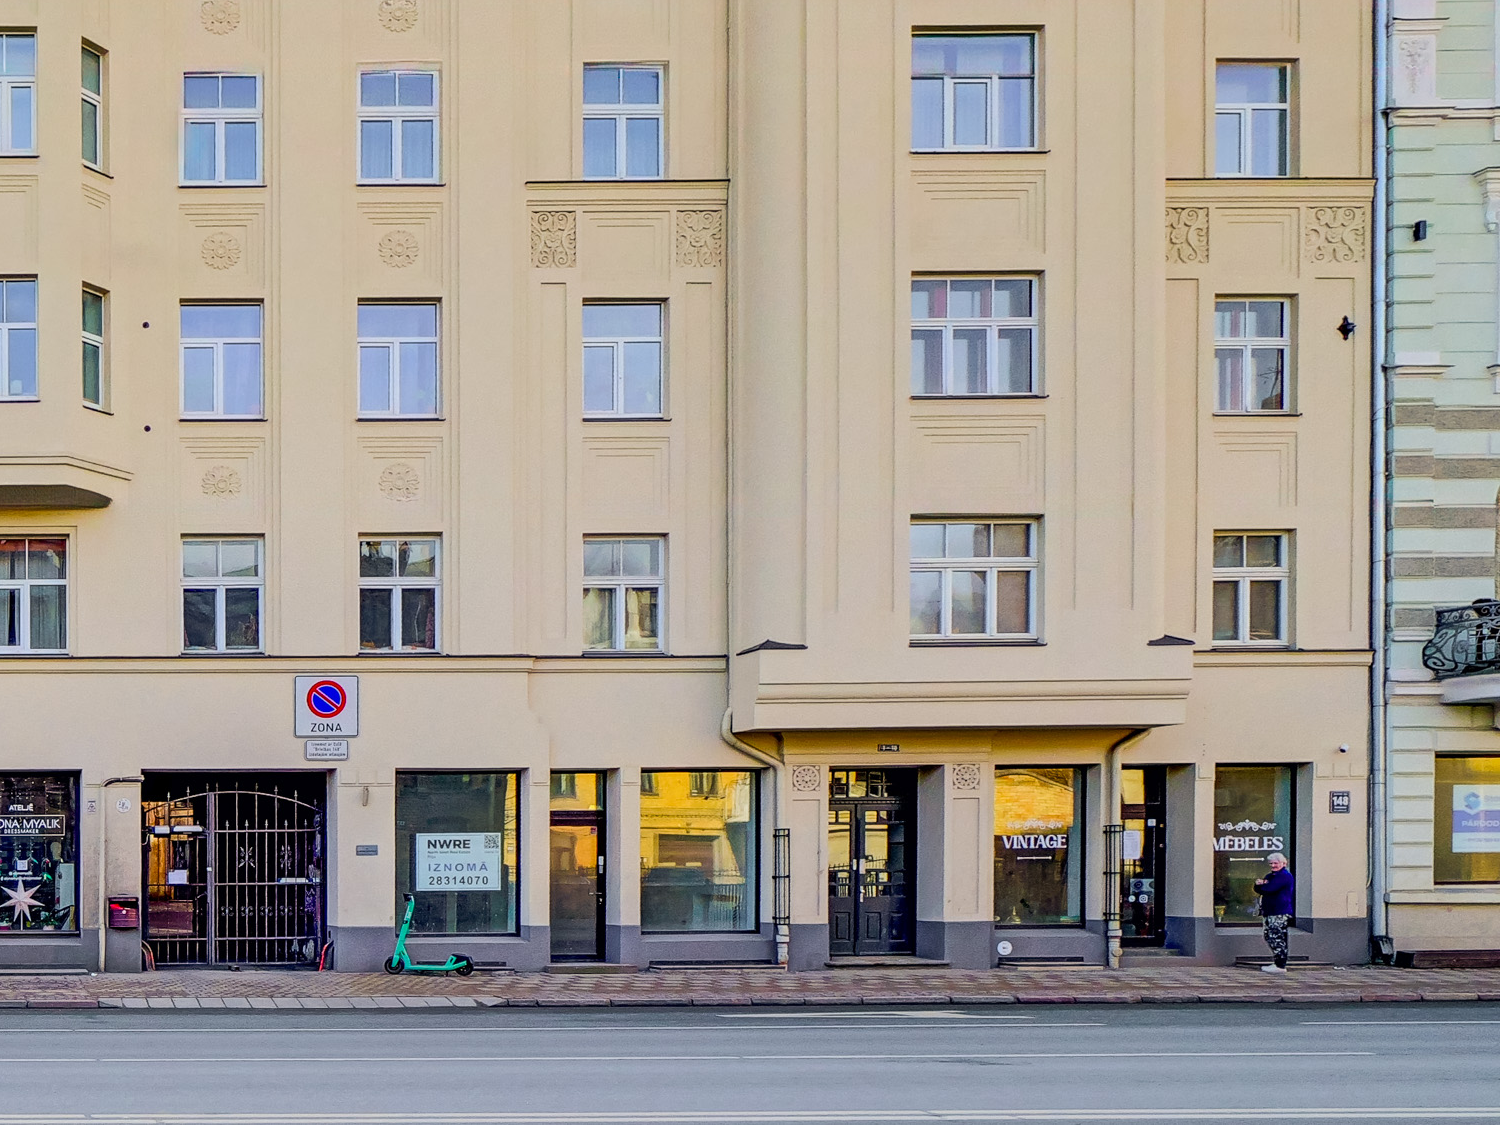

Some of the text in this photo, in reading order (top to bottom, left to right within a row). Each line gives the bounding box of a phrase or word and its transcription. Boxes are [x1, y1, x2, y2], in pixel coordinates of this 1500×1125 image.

[311, 723, 342, 732] ZONA
[1332, 796, 1349, 806] 148
[9, 803, 33, 811] ATELJĒ
[23, 819, 60, 828] MYALIK
[427, 839, 471, 850] NWRE
[1002, 834, 1067, 849] VINTAGE
[1213, 835, 1283, 851] MĒBELES
[428, 861, 488, 872] IZNOMĀ
[428, 875, 489, 886] 28314070
